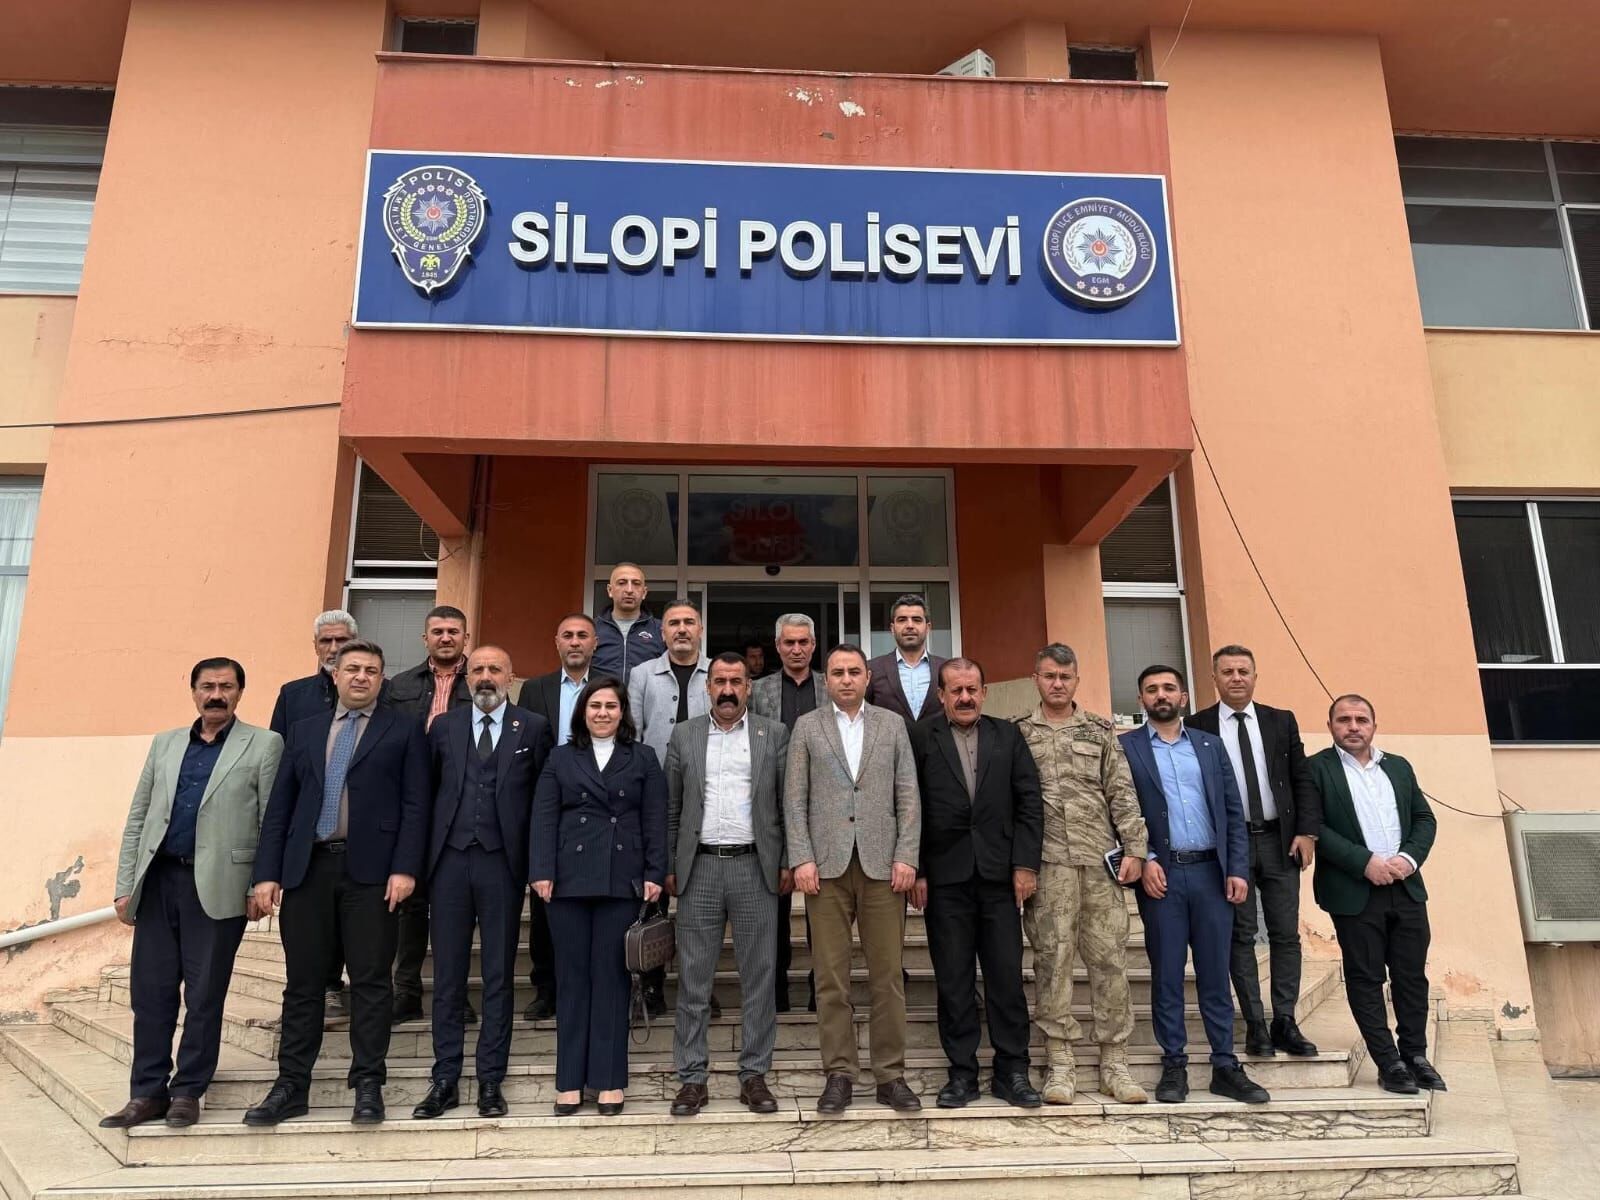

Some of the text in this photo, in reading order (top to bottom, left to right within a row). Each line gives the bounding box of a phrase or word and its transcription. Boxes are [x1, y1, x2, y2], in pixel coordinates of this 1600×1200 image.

[408, 171, 465, 188] POLİS
[1074, 202, 1115, 216] EMNİYET
[413, 242, 450, 251] GENEL
[508, 201, 1022, 279] SİLOPİ POLİSEVİ
[1091, 276, 1110, 285] EGM
